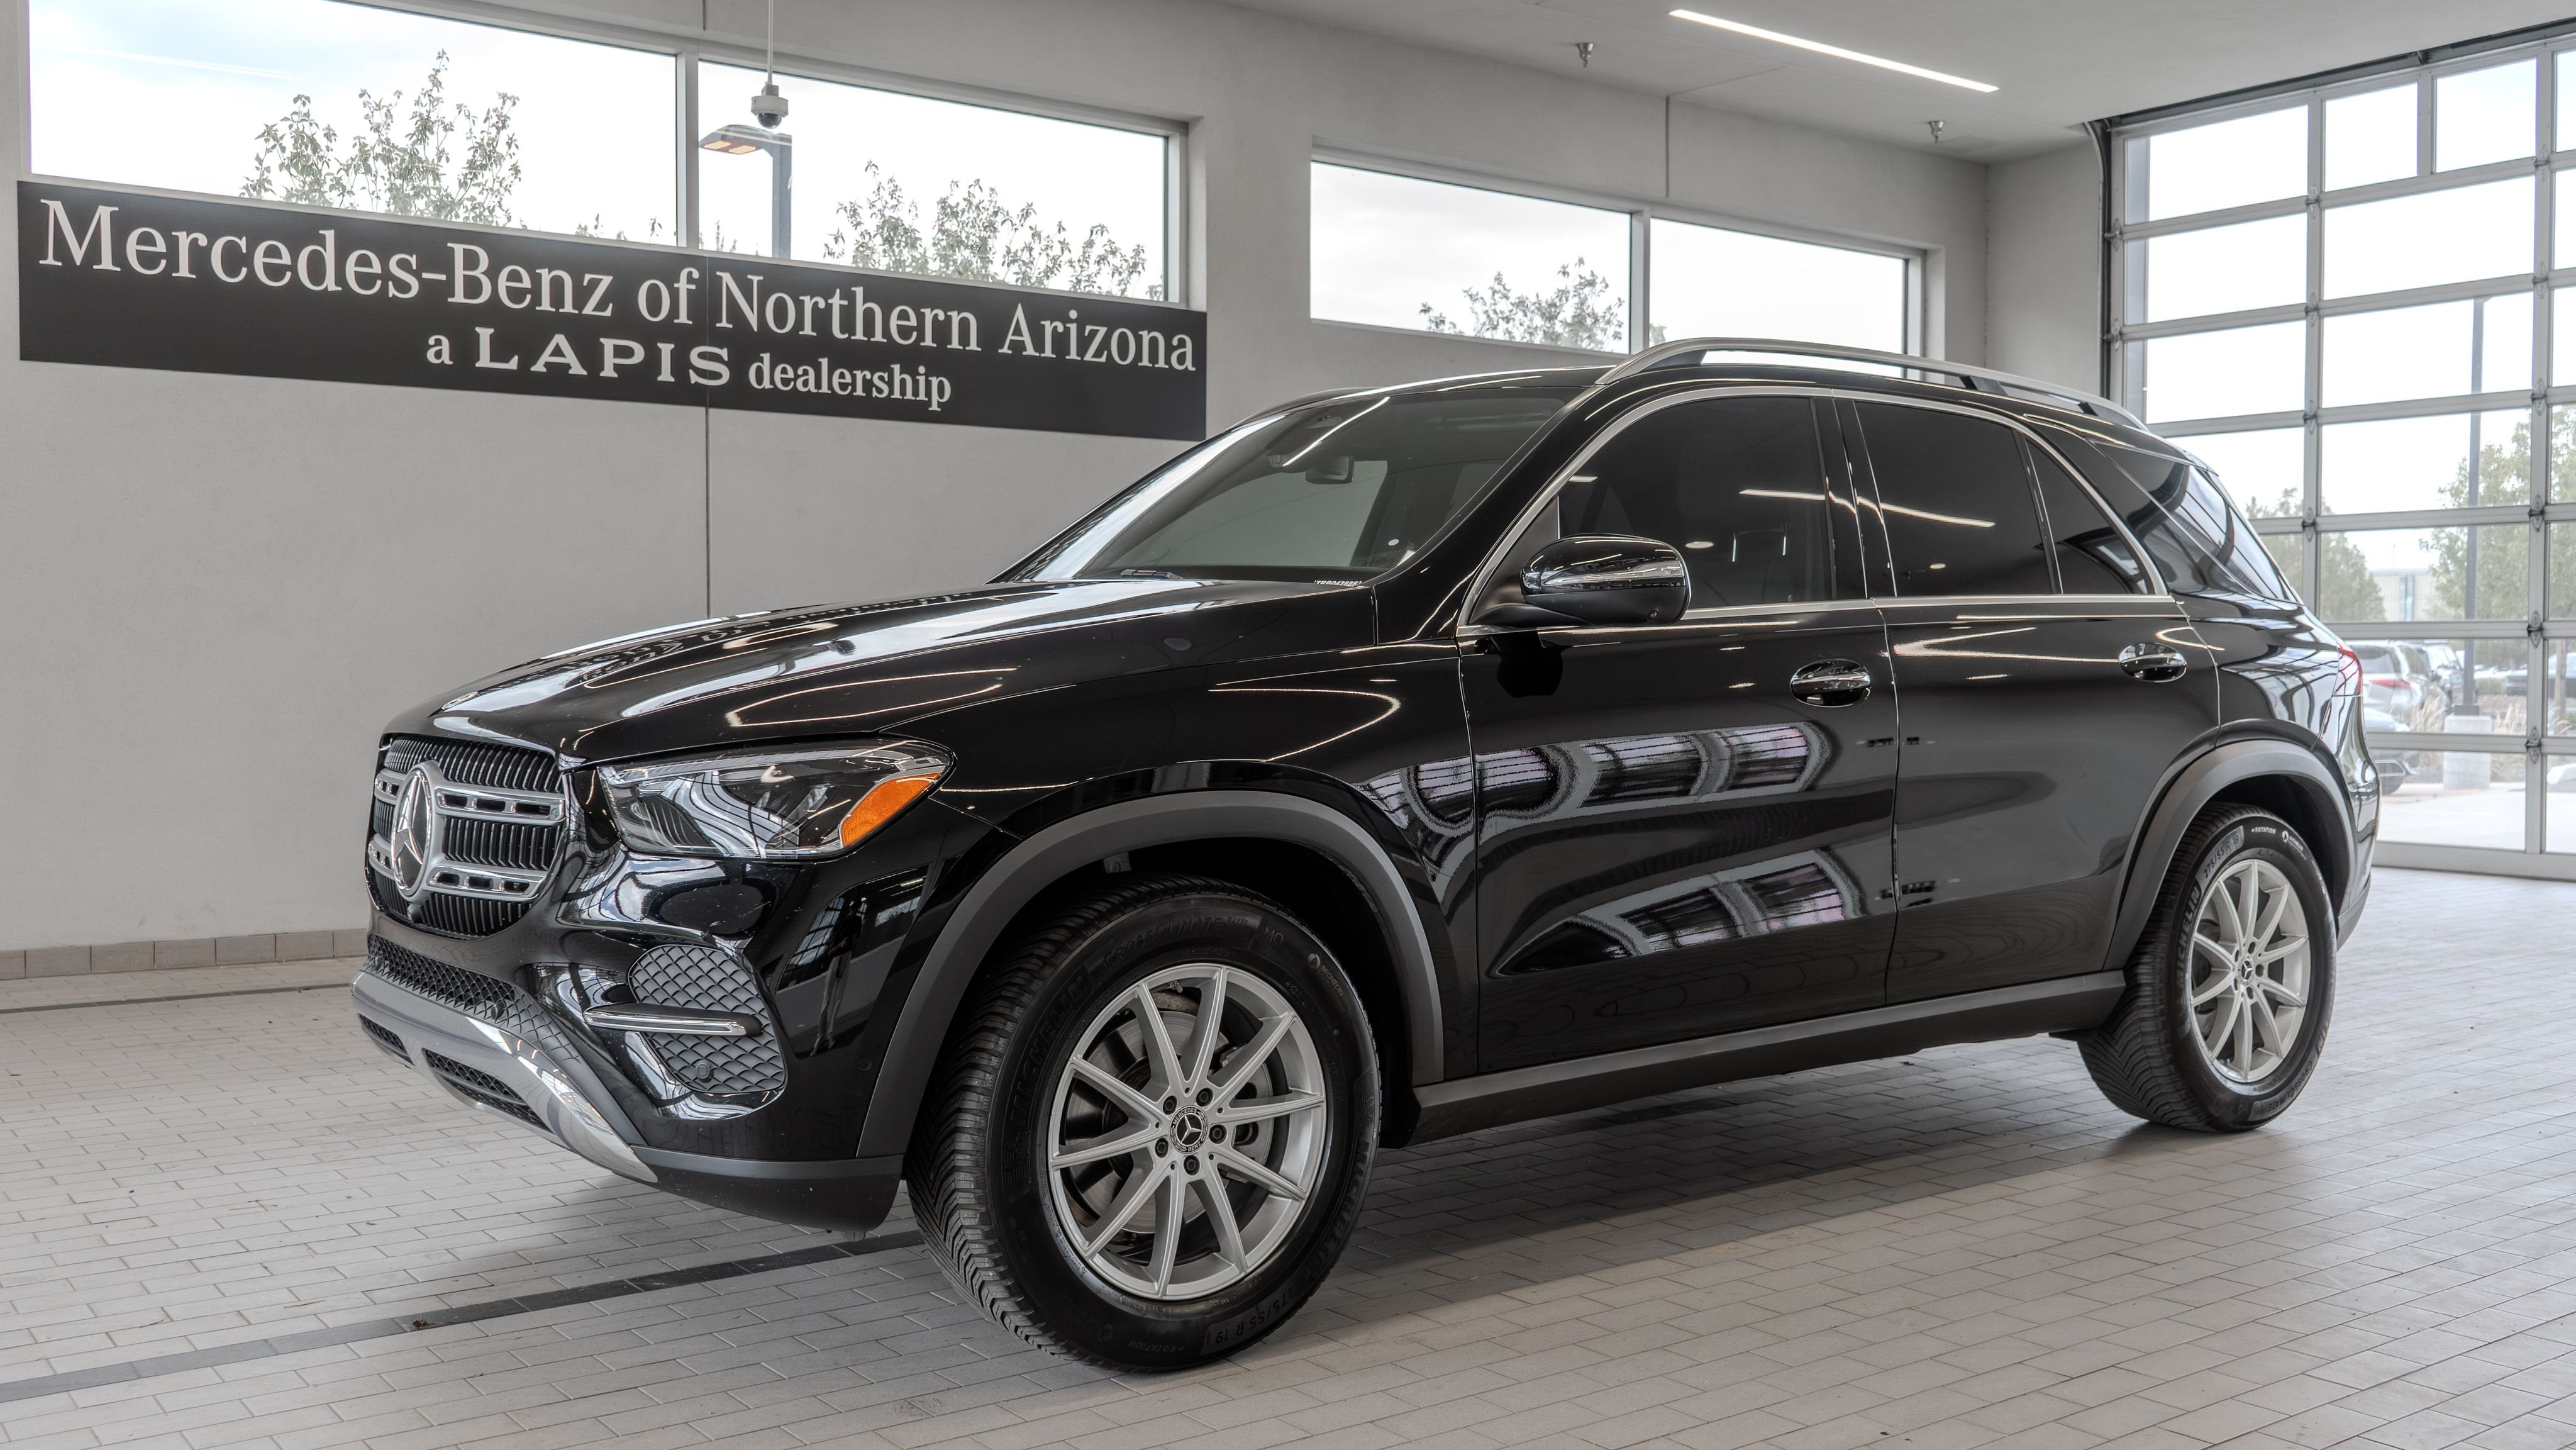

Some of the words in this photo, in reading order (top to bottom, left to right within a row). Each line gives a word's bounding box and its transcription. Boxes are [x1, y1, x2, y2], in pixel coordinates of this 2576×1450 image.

[38, 198, 614, 317] Mercedes-Benz
[637, 267, 700, 325] of
[715, 270, 982, 352] Northern
[997, 303, 1197, 372] Arizona
[426, 335, 453, 365] a
[475, 326, 731, 386] LAPIS
[748, 352, 952, 411] dealership
[2232, 834, 2240, 844] 19
[2176, 886, 2201, 988] MICHELIN
[1321, 964, 1345, 997] MICHELIN
[1010, 975, 1088, 1128] MICHELIN
[1172, 1107, 1197, 1125] MERCEDES
[1188, 1141, 1202, 1152] BENZ
[1250, 1285, 1295, 1325] 275/55
[1216, 1330, 1229, 1344] 19
[1236, 1322, 1245, 1335] R
